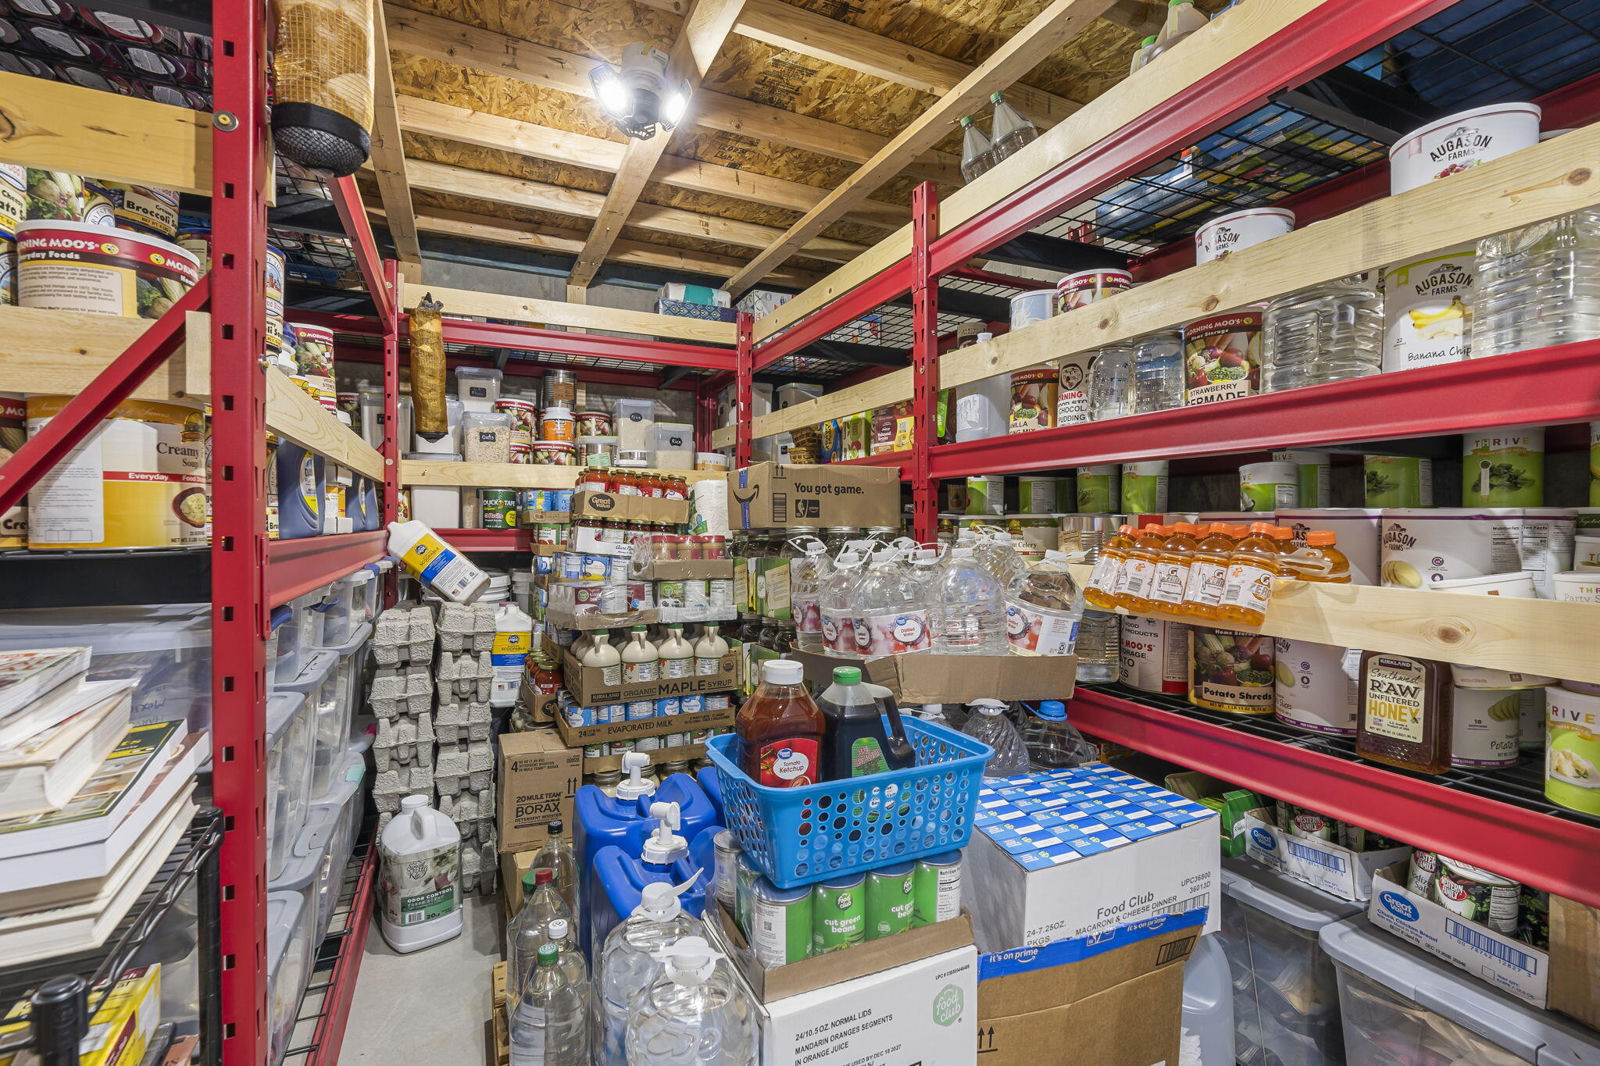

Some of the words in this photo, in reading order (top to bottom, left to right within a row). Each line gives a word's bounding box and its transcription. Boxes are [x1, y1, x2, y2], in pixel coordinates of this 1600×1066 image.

[126, 200, 170, 224] Broccoli
[49, 238, 95, 250] MOO'S
[1415, 272, 1474, 296] AUGASON
[1431, 284, 1458, 296] FARMS
[1408, 350, 1446, 362] Banana
[1190, 382, 1237, 398] STRAWBERRY
[156, 441, 198, 459] Creamy
[1475, 437, 1529, 448] THRIVE
[128, 472, 168, 482] Everyday
[794, 482, 813, 493] You
[814, 484, 832, 494] got
[834, 484, 864, 495] game.
[1383, 532, 1416, 548] AUGASON
[1126, 640, 1153, 652] MOO'S
[1380, 658, 1412, 668] KIRKLAND
[1371, 668, 1422, 684] Southwest
[623, 687, 657, 698] ORGANIC
[658, 680, 706, 695] MAPLE
[707, 680, 732, 688] SYRUP
[1204, 686, 1236, 700] Potato
[1238, 690, 1272, 701] Shreds
[1370, 679, 1422, 700] RAW
[1368, 692, 1420, 708] UNFILTERED
[1368, 699, 1420, 725] HONEY
[578, 730, 587, 738] 24
[608, 722, 655, 734] EVAPORATED
[656, 720, 673, 728] MILK
[1490, 740, 1514, 751] Potato
[511, 760, 518, 773] 4
[780, 766, 804, 774] Ketchup
[516, 802, 560, 818] BORAX
[1253, 828, 1272, 844] Great
[426, 888, 453, 900] CONTROL
[890, 904, 904, 913] cut
[1096, 900, 1126, 920] Food
[1128, 891, 1155, 908] Club
[1383, 894, 1412, 912] Great
[1390, 904, 1412, 918] Value
[824, 918, 840, 926] cut
[840, 914, 861, 928] green
[1075, 918, 1114, 936] MACARONI
[1122, 905, 1150, 921] CHEESE
[1151, 895, 1178, 910] DINNER
[832, 924, 856, 934] beans
[990, 952, 1002, 962] it's
[1014, 948, 1038, 962] prime
[936, 988, 958, 1016] food
[940, 1004, 960, 1023] club
[795, 1028, 818, 1042] 24/10.5
[818, 1024, 831, 1033] OZ.
[831, 1014, 858, 1029] NORMAL
[858, 1008, 872, 1020] LIDS
[794, 1036, 830, 1055] MANDARIN
[830, 1026, 860, 1042] ORANGES
[861, 1014, 893, 1032] SEGMENTS
[794, 1058, 802, 1066] IN
[802, 1049, 830, 1064] ORANGE
[831, 1041, 849, 1055] JUICE
[874, 1051, 884, 1060] DEC
